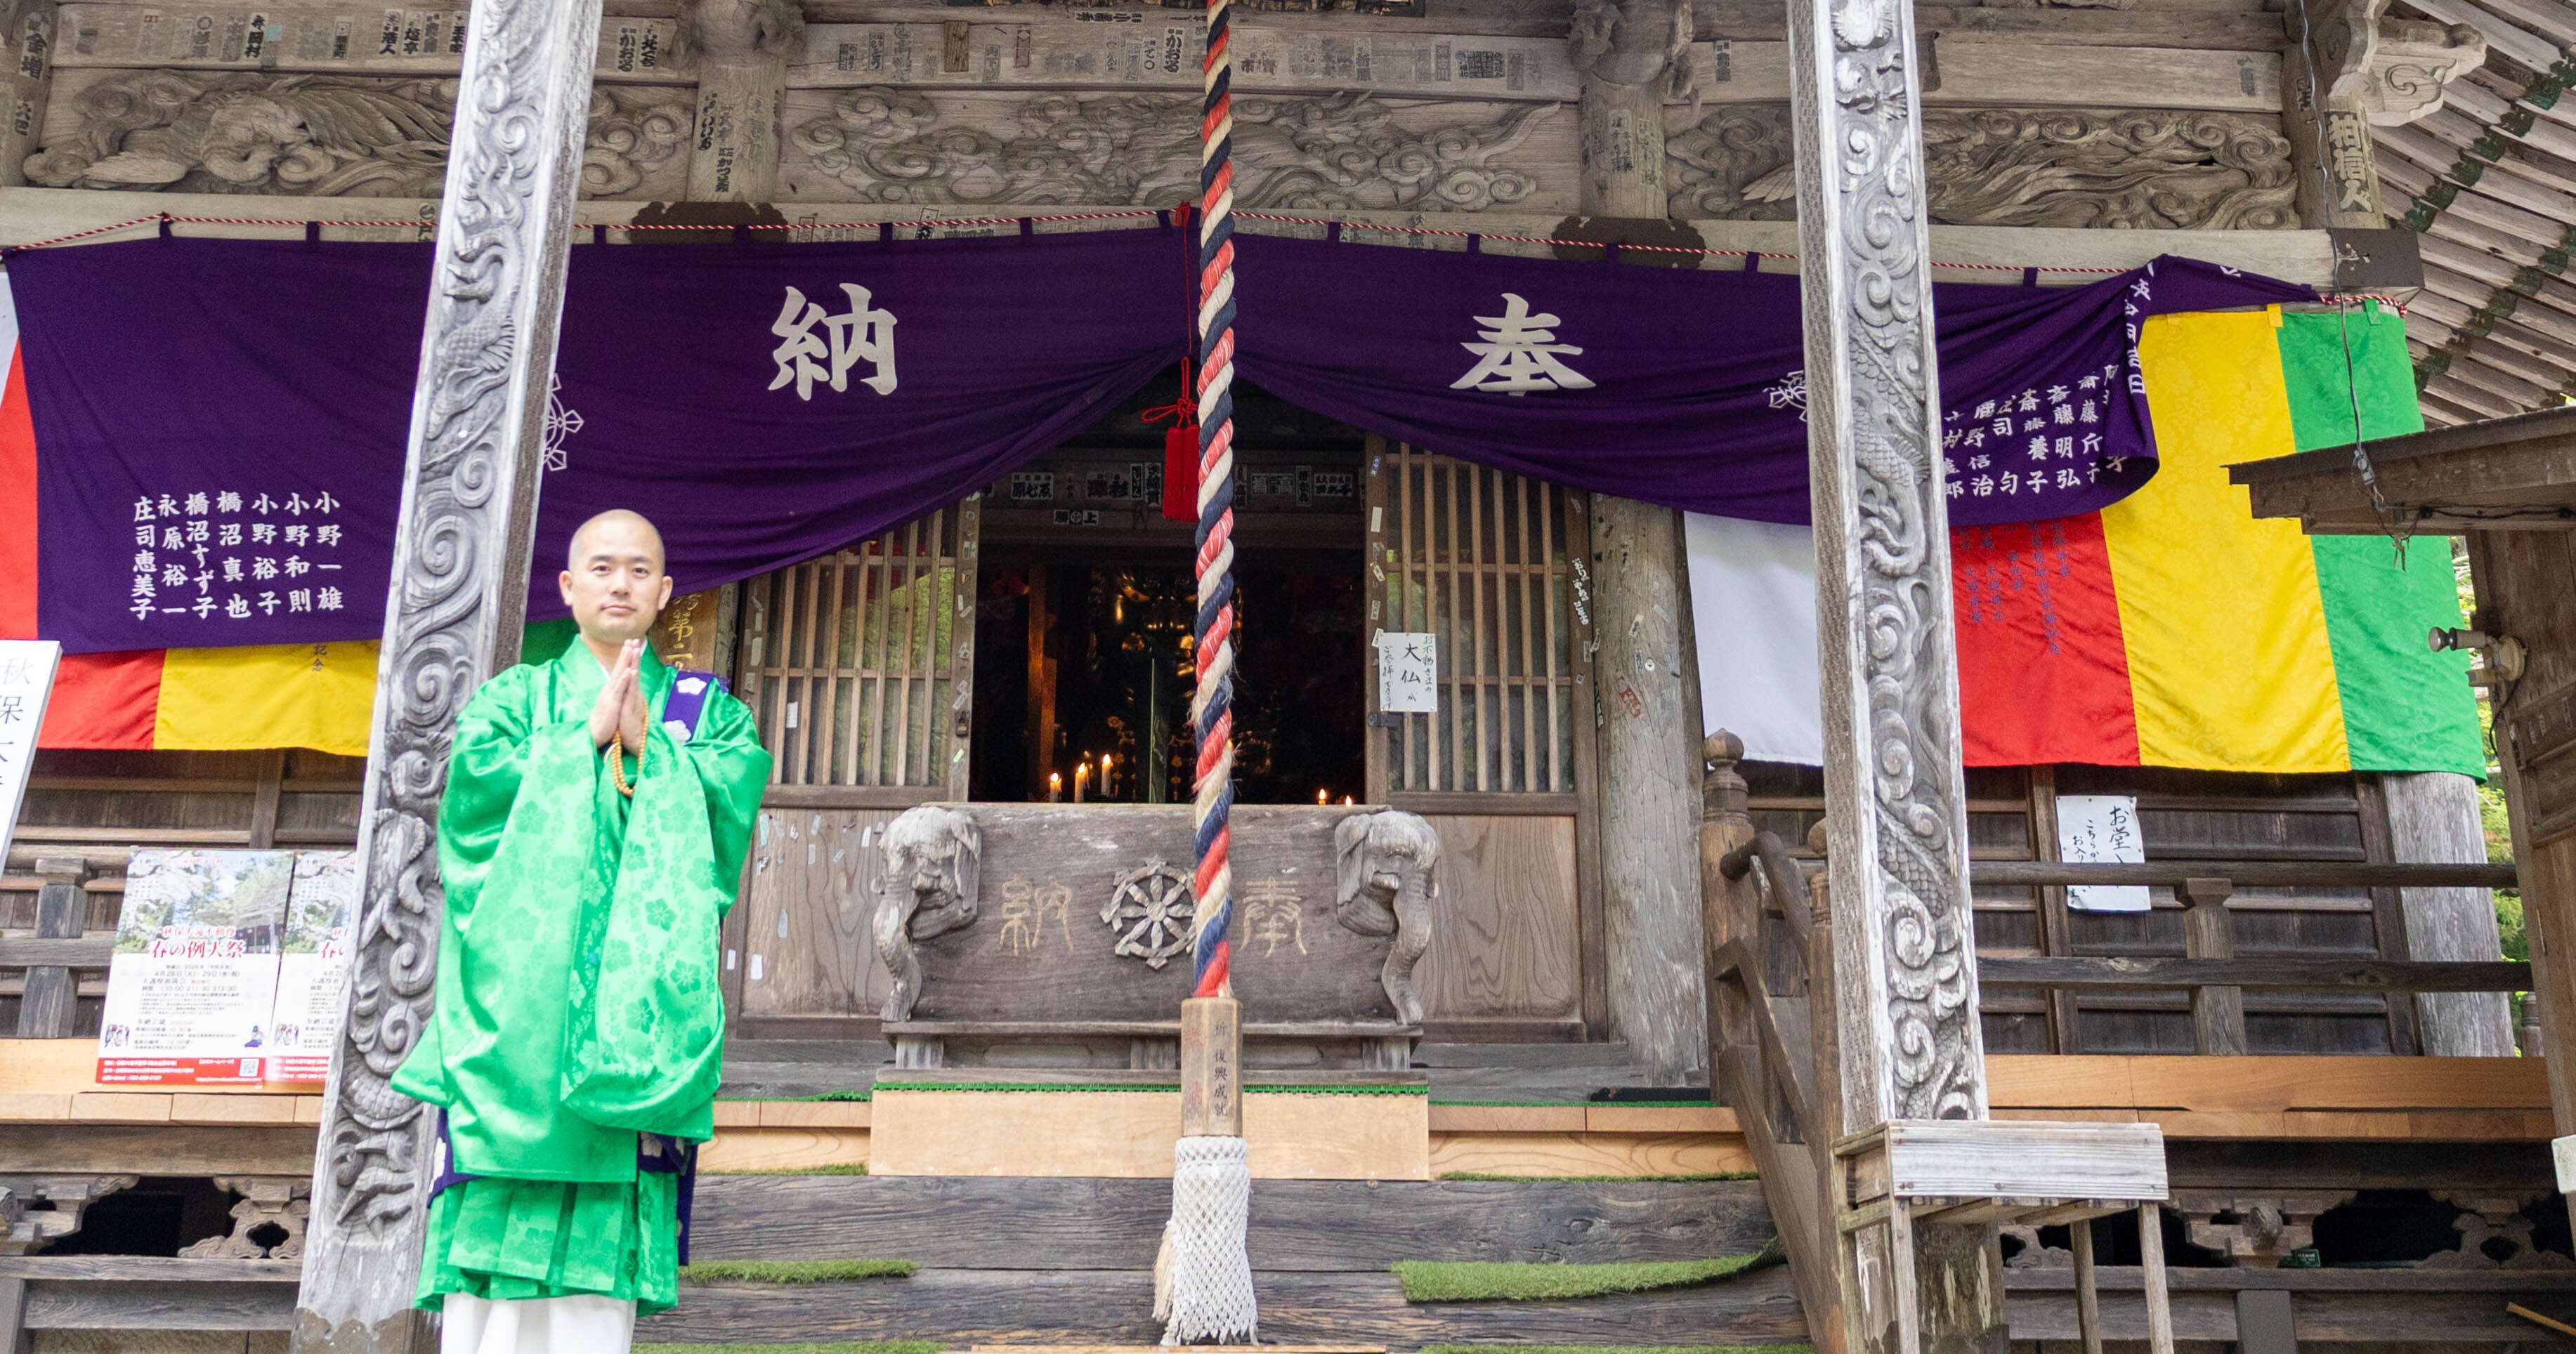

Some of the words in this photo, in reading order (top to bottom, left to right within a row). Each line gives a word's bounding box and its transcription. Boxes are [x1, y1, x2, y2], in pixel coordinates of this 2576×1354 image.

[768, 283, 898, 401] 納
[1449, 293, 1596, 396] 奉
[157, 494, 189, 614] 永原裕一
[184, 492, 218, 619] 橋沼すず子
[216, 490, 252, 619] 橋沼真也
[251, 492, 282, 616] 小野裕子
[284, 492, 311, 613] 小野和則
[314, 491, 344, 611] 小野一雄
[152, 940, 244, 959] 春の例大祭
